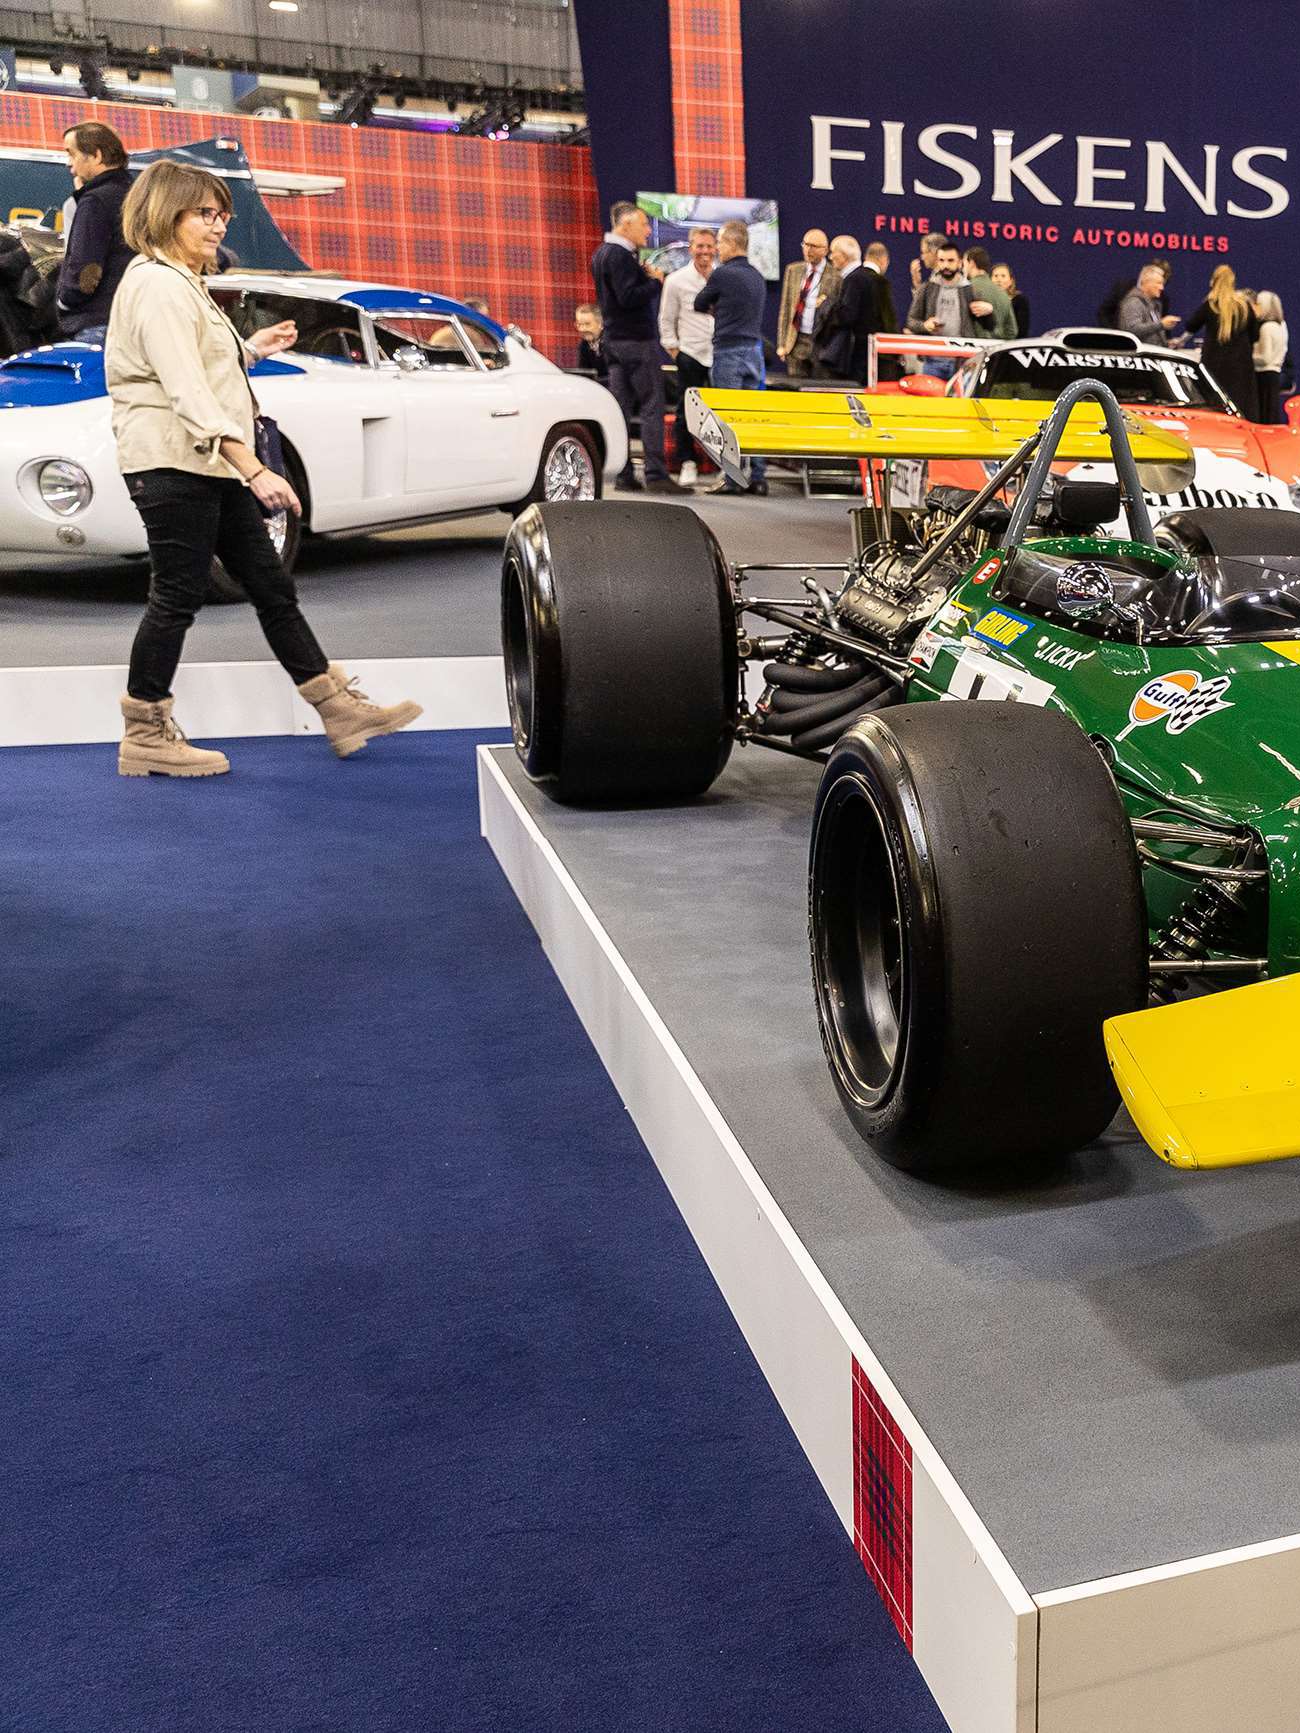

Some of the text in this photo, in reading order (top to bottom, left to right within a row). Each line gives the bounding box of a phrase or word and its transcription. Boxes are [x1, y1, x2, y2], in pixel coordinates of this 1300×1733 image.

[809, 114, 1290, 220] FISKENS
[874, 215, 1230, 253] FINE HISTORIC AUTOMOBILES
[1009, 347, 1199, 380] WARSTEINER
[976, 561, 998, 582] E
[973, 610, 1029, 646] GIRLING
[1143, 682, 1186, 708] Gulf
